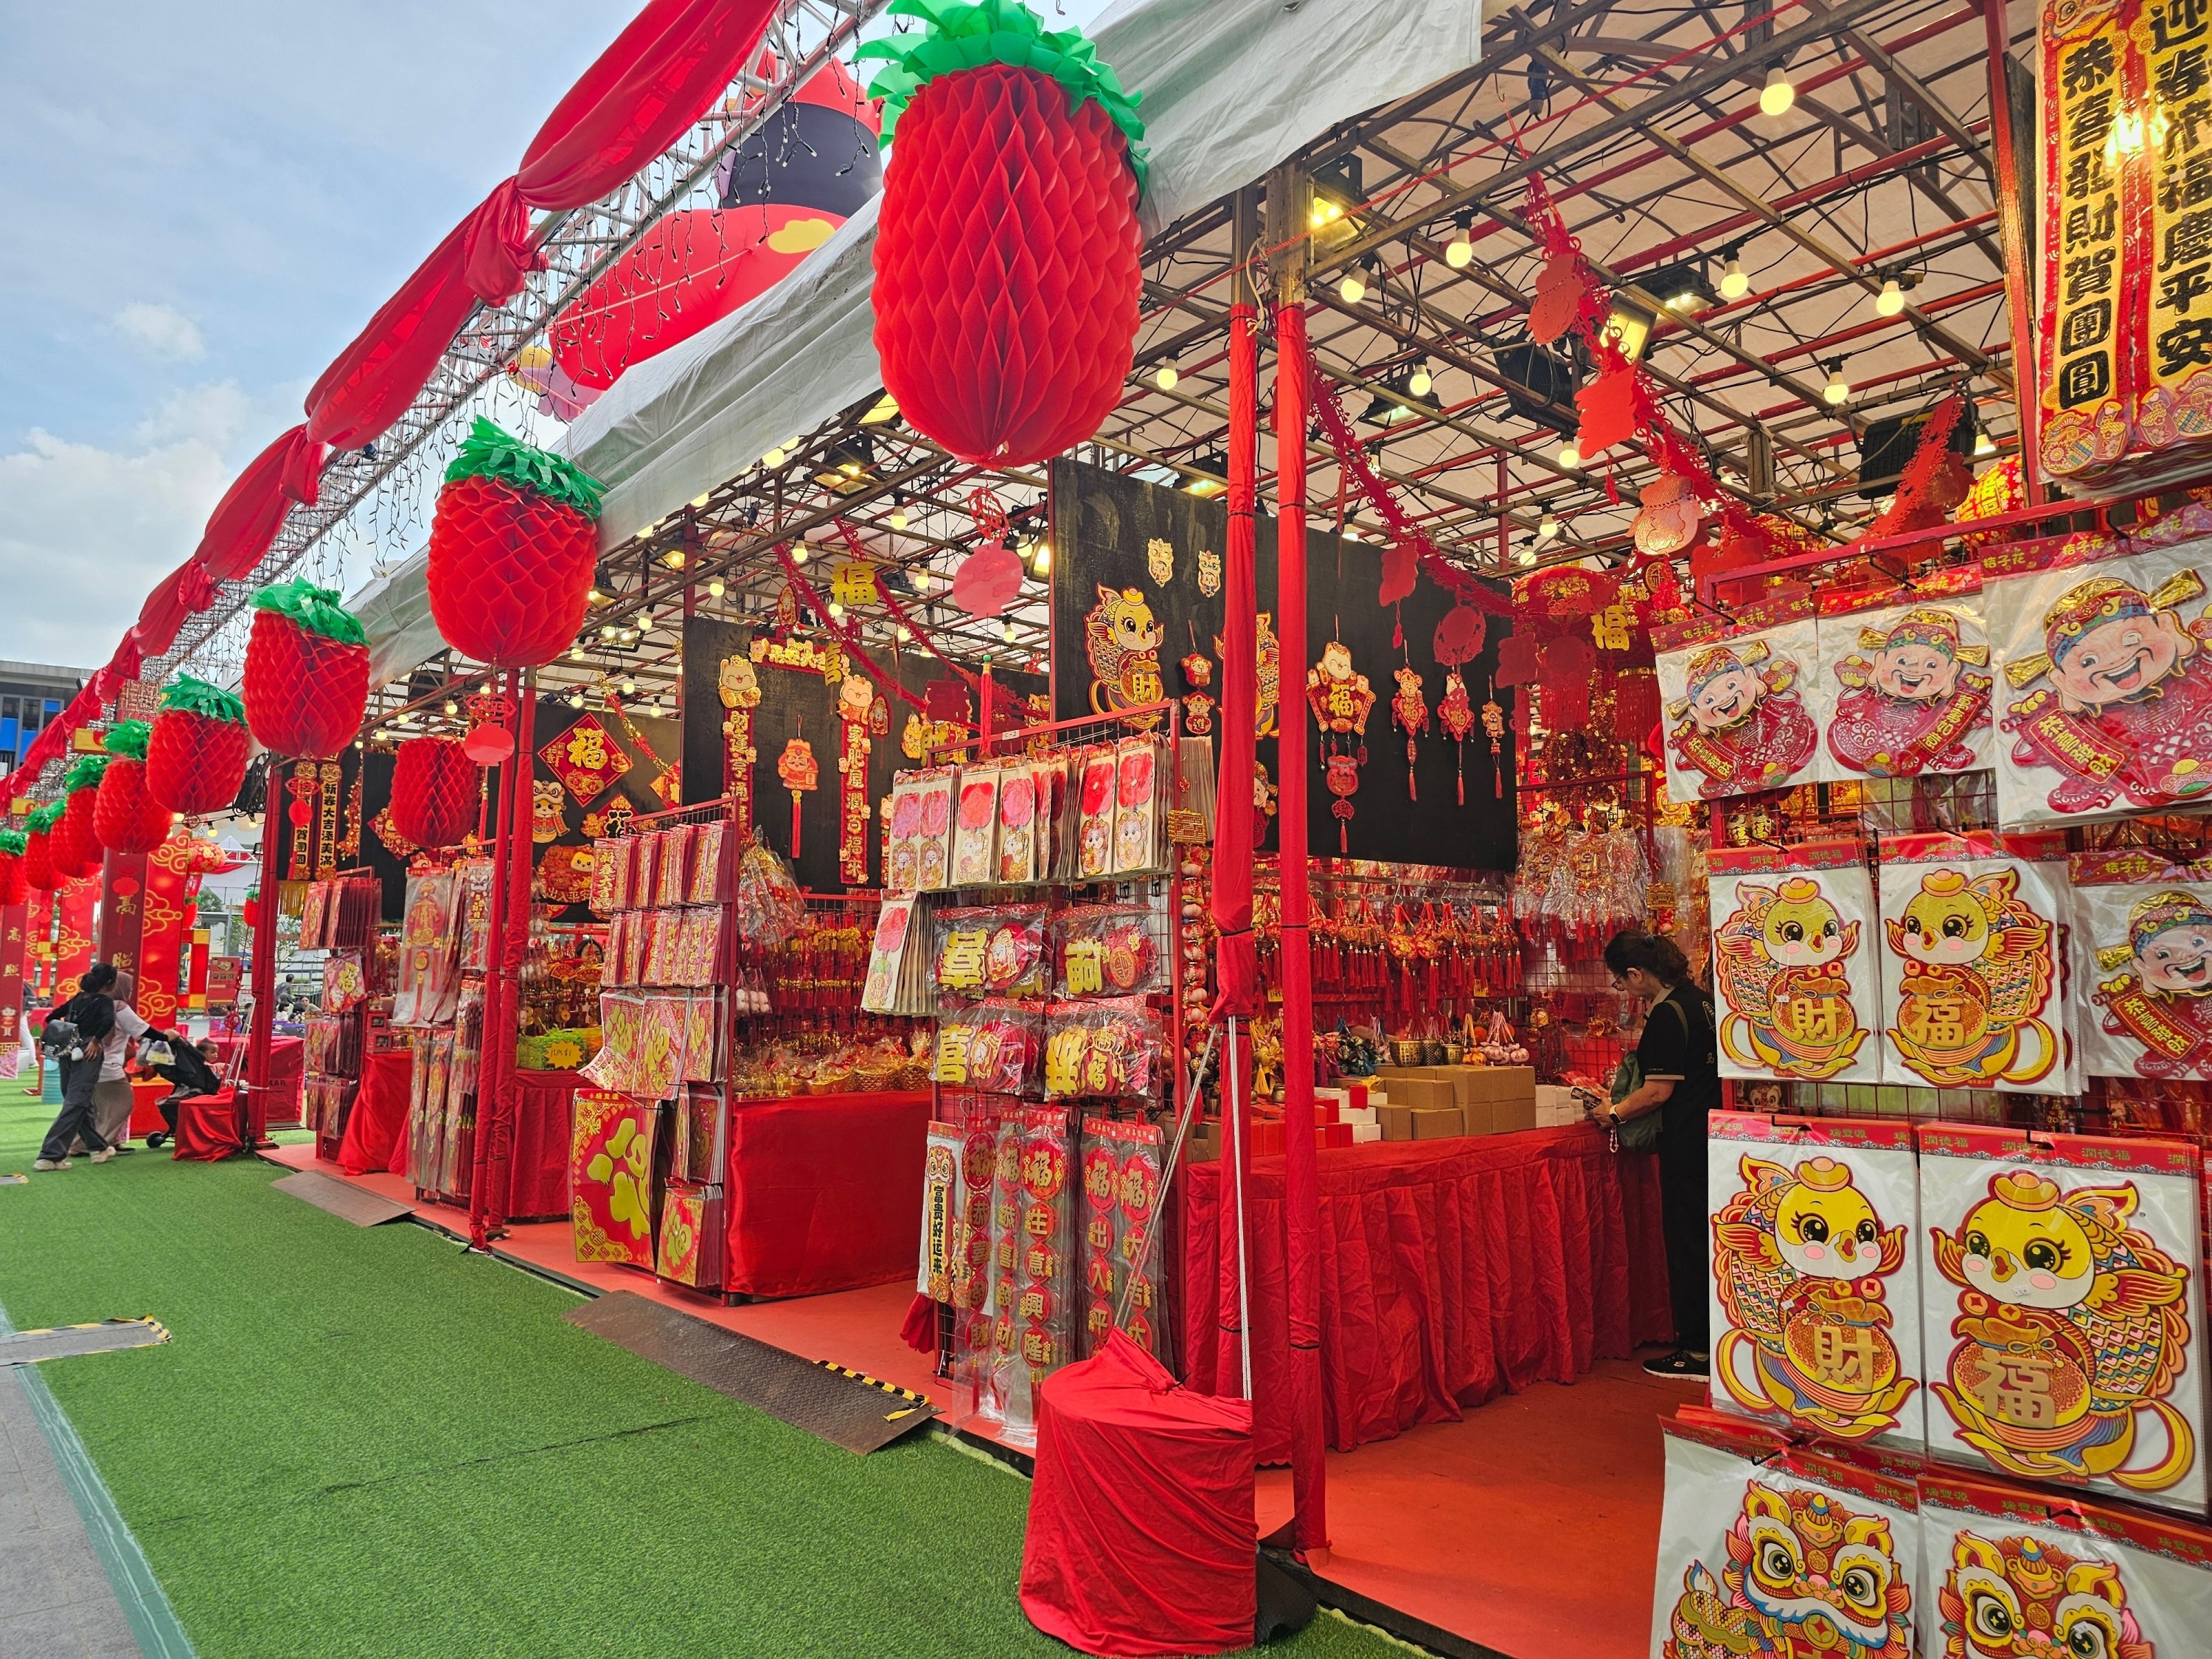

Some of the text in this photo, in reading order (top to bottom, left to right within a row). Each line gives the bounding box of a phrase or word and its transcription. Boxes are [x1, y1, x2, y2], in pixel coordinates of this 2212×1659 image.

[1983, 549, 2025, 569] 桔子花
[2062, 535, 2104, 556] 桔子花
[830, 561, 878, 607] 福
[1590, 605, 1630, 651] 福
[1683, 624, 1714, 640] 桔子花
[1737, 610, 1767, 627] 桔子花
[1132, 674, 1158, 703] 財
[1329, 683, 1354, 718] 福
[567, 727, 609, 770] 福
[1688, 737, 1733, 777] 恭喜發財
[2038, 714, 2117, 778] 恭喜發財
[319, 783, 338, 866] 新春大吉添美滿
[1809, 849, 1843, 861] 潤德福
[1926, 841, 1964, 853] 瑞豐源
[598, 851, 616, 899] 新春大吉
[2106, 855, 2149, 874] 桔子花
[547, 887, 591, 903] 出入平安
[1792, 997, 1842, 1041] 財
[1910, 995, 1965, 1047] 福
[2124, 997, 2191, 1054] 恭喜發財
[1829, 1128, 1867, 1138] 瑞豐源
[1924, 1135, 1969, 1148] 潤德福
[1001, 1146, 1022, 1181] 福
[1030, 1150, 1053, 1186] 福
[2081, 1147, 2131, 1161] 潤德福
[1091, 1158, 1110, 1197] 福
[1122, 1168, 1147, 1208] 福
[932, 1185, 945, 1275] 富贵好运来
[1022, 1208, 1048, 1363] 生意興隆
[1814, 1325, 1880, 1391] 財
[1972, 1348, 2056, 1429] 福
[1811, 1446, 1851, 1460] 瑞豐源
[1879, 1455, 1921, 1471] 瑞豐源
[1804, 1461, 1844, 1482] 潤德福
[1874, 1482, 1916, 1505] 潤德福
[1925, 1486, 1969, 1503] 瑞豐源
[2001, 1500, 2047, 1515] 瑞豐源
[2158, 1535, 2205, 1557] 瑞豐源
